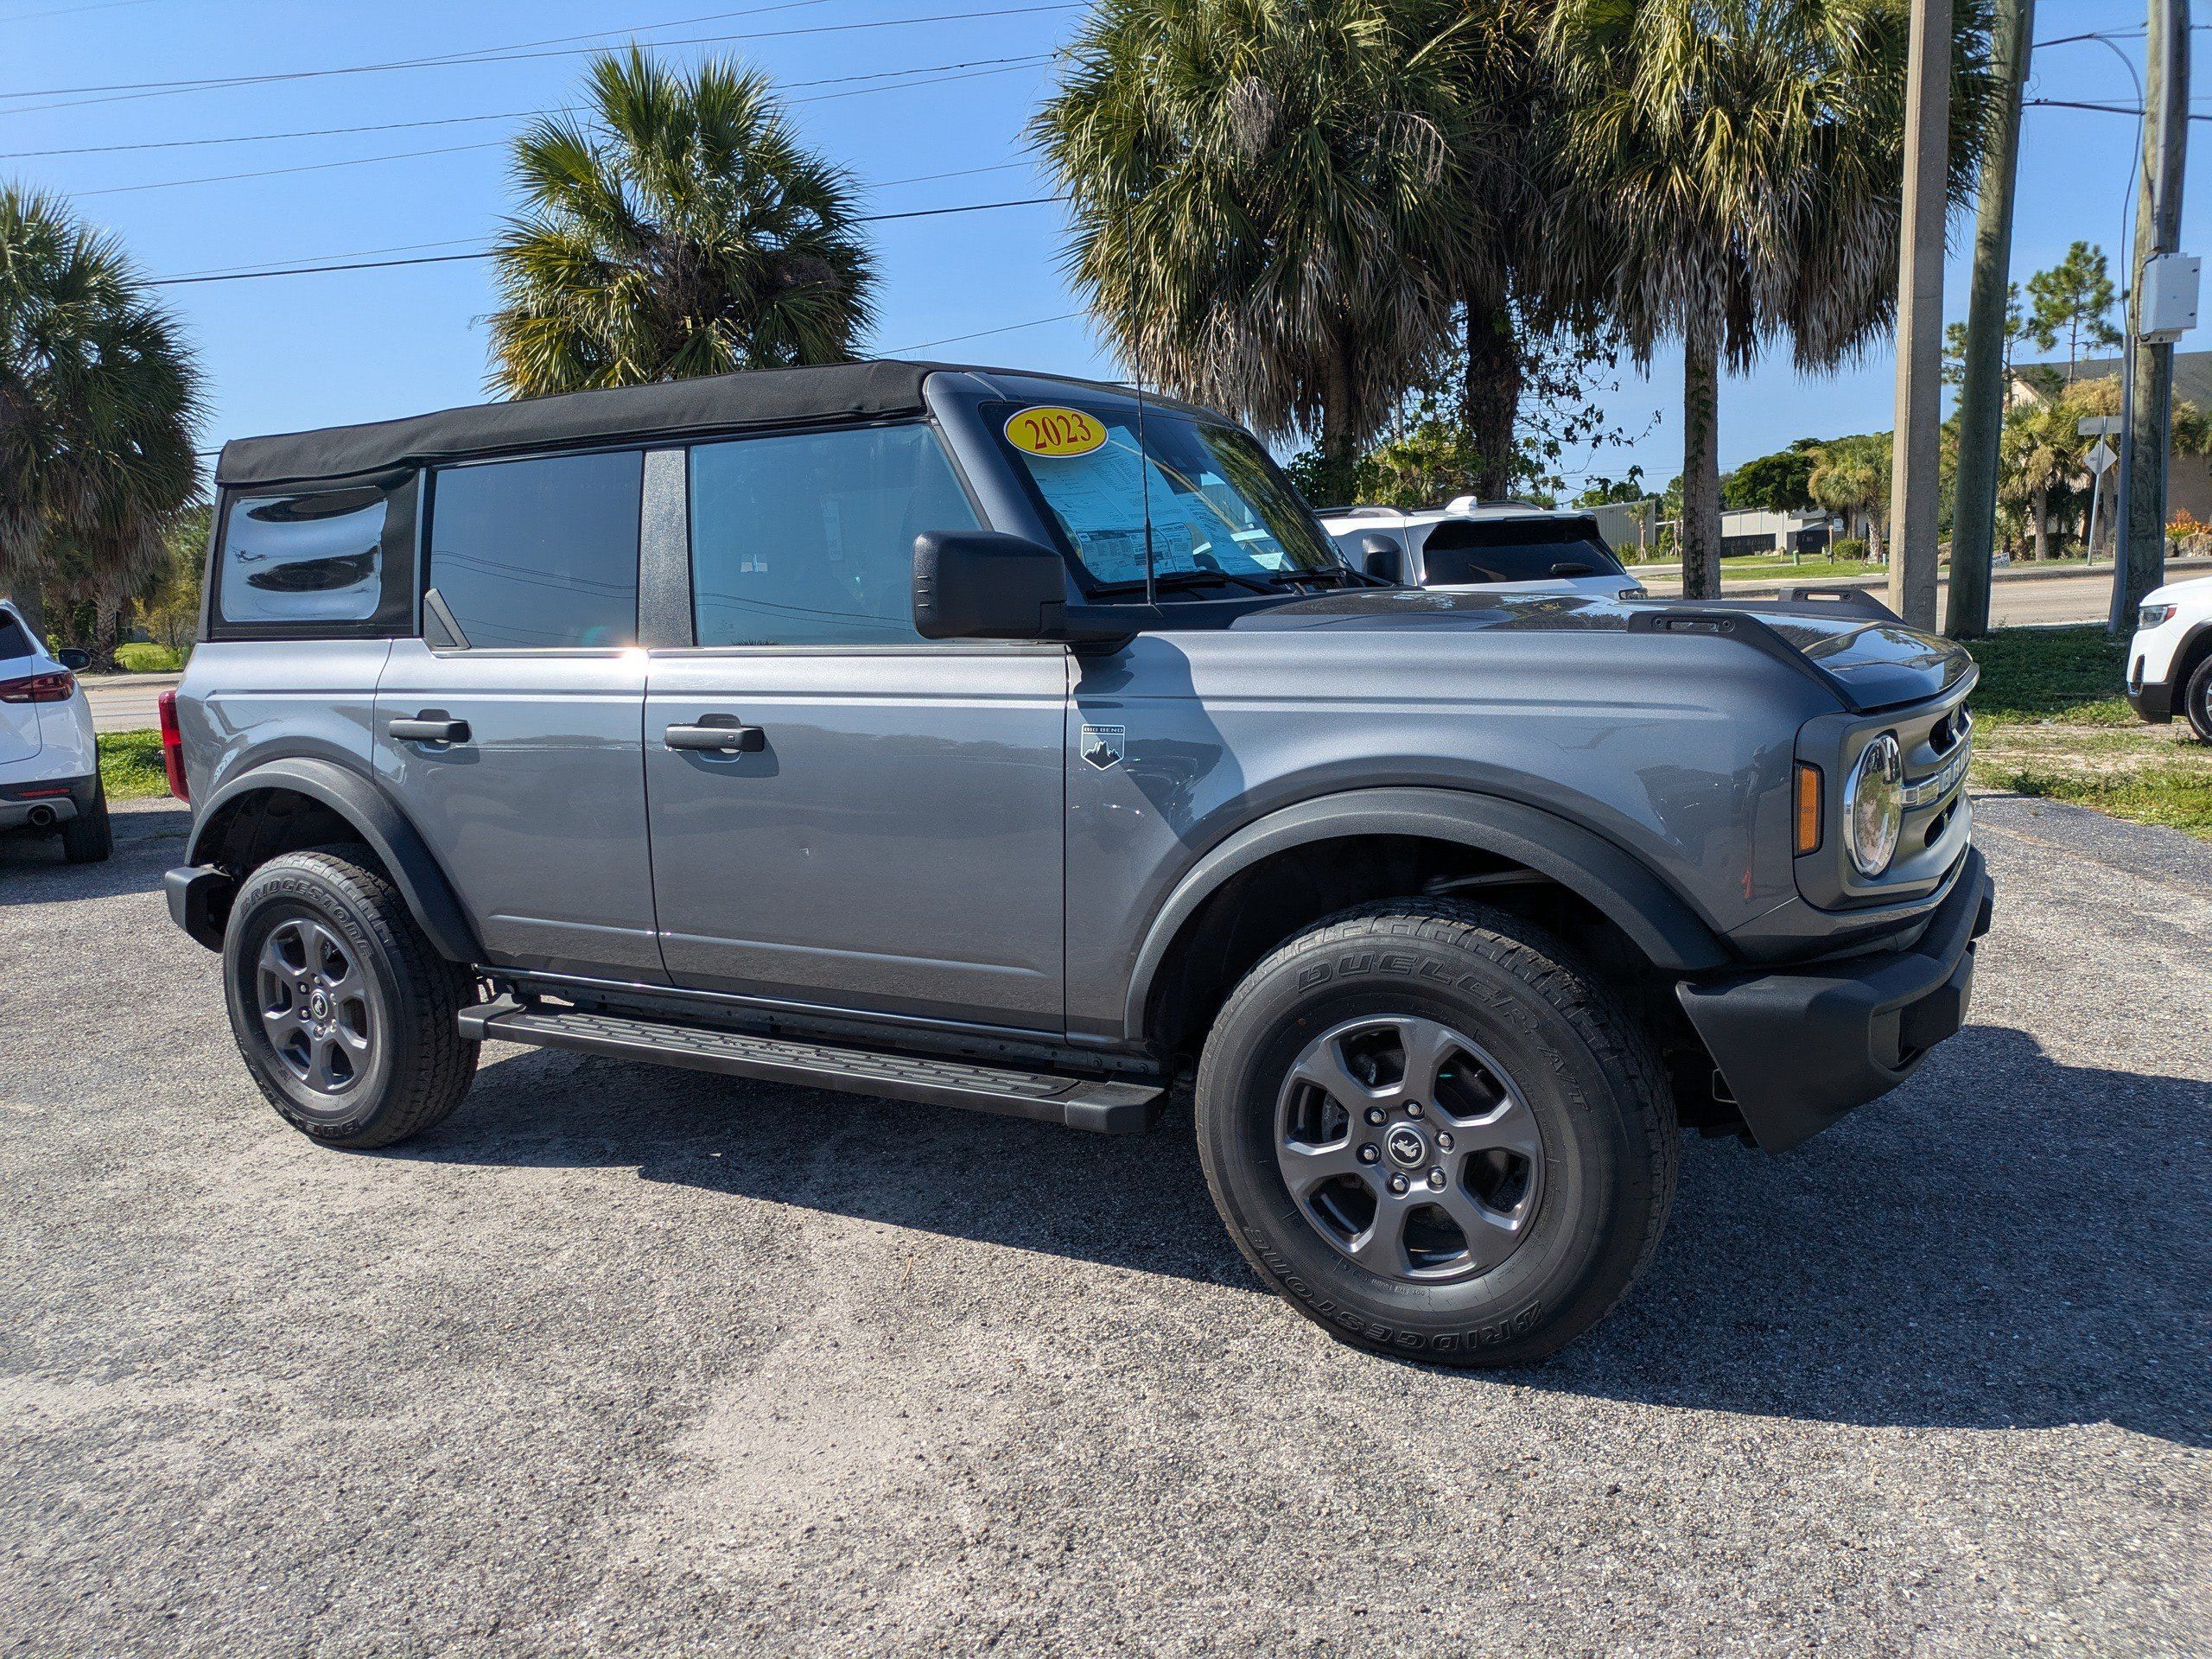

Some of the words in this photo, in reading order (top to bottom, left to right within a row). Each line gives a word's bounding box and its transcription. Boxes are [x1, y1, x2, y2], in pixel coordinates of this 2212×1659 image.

[1024, 413, 1091, 449] 2023
[239, 876, 374, 958] BRIDGESTONE
[1298, 951, 1540, 1035] DUELER
[1537, 1046, 1591, 1111] A/T
[1243, 1225, 1544, 1351] BRIDGESTONE
